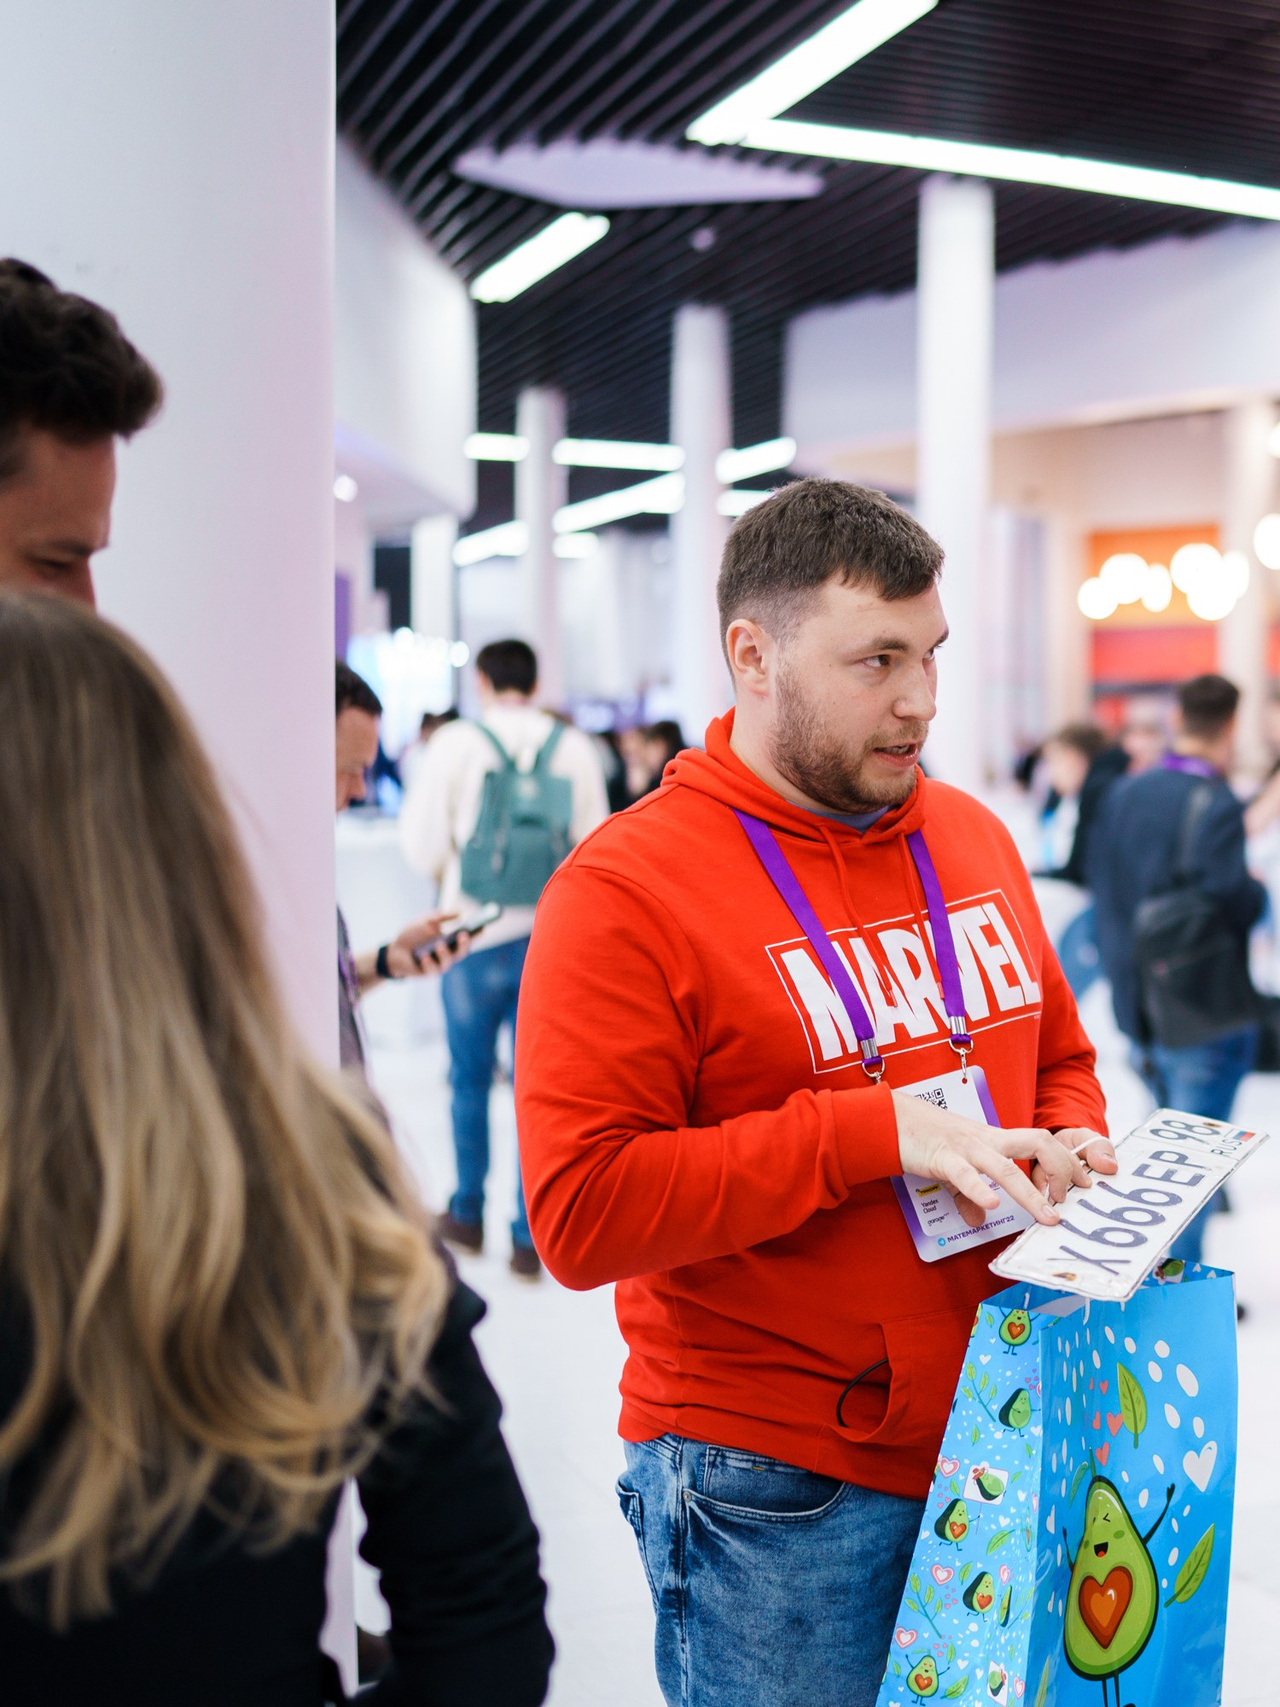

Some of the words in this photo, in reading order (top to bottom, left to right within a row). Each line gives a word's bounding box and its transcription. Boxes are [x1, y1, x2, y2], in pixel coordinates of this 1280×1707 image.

[780, 901, 1042, 1062] MARVEL
[1149, 1119, 1221, 1145] 98
[1210, 1138, 1244, 1157] RUS
[921, 1199, 939, 1208] Yandex
[923, 1205, 937, 1214] Cloud
